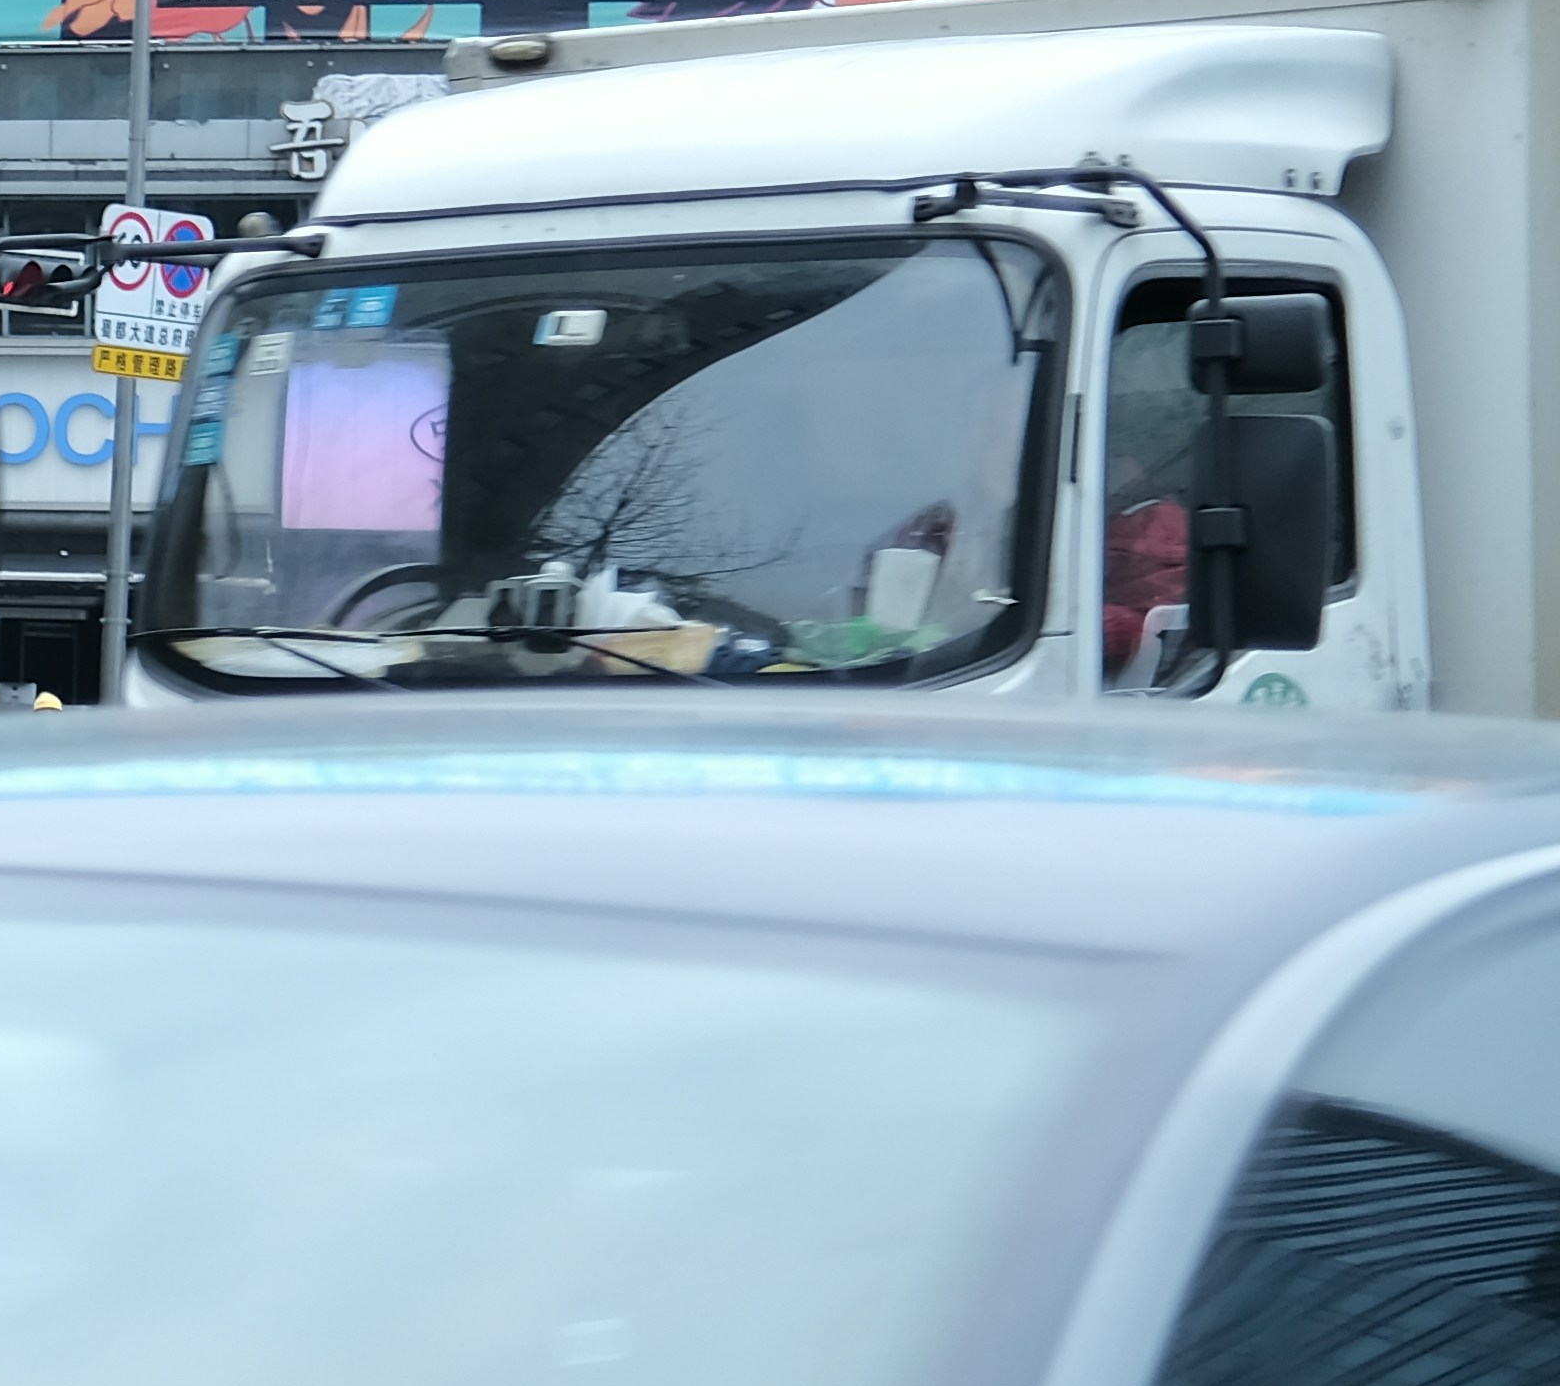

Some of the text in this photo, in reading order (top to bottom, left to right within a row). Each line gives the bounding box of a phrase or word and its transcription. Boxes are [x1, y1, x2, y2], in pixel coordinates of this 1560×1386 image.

[98, 350, 189, 378] 严格管理路
